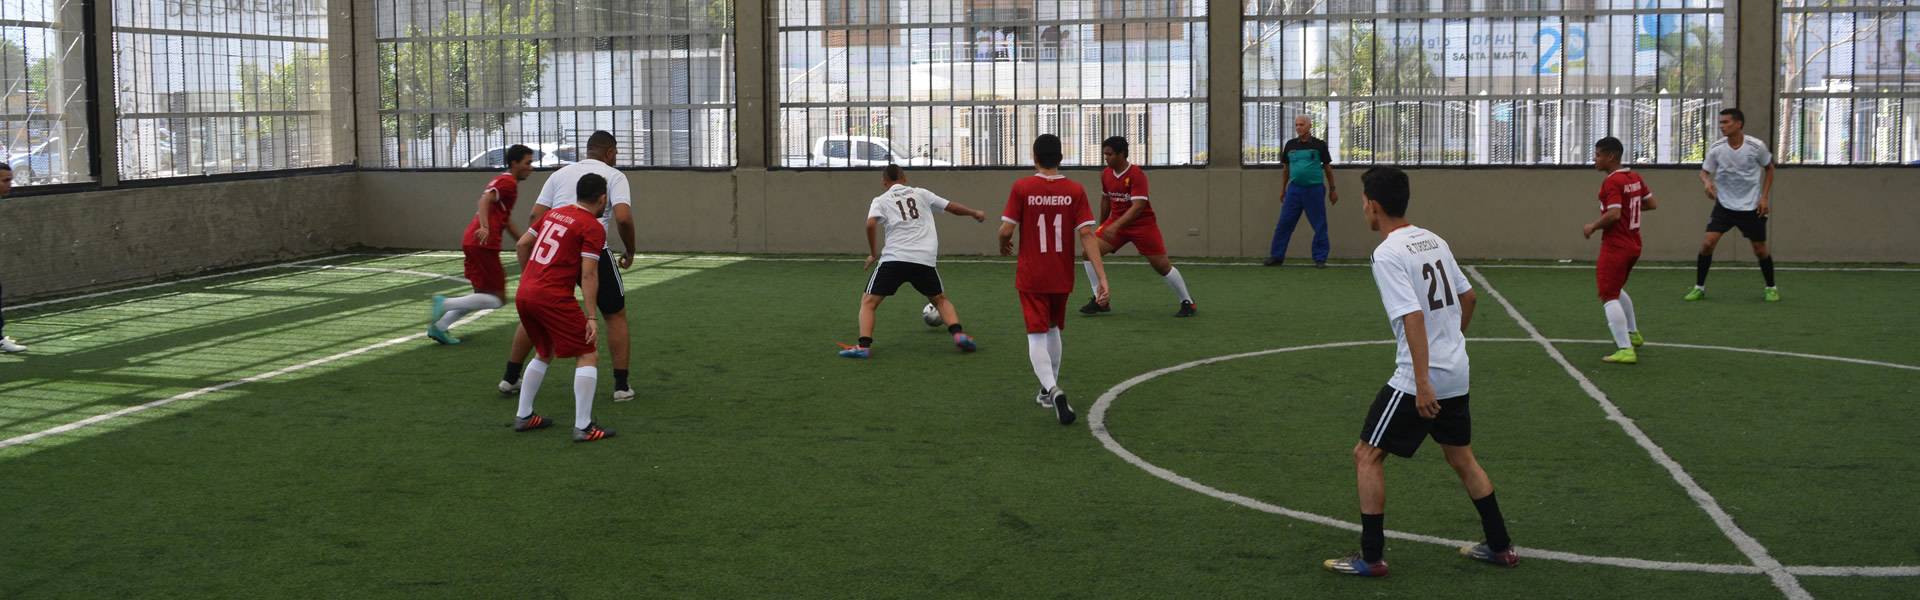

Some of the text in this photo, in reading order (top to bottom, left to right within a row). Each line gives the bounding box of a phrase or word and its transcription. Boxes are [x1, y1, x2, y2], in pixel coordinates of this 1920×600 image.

[1452, 52, 1486, 61] SANTA
[895, 197, 919, 220] 18
[1028, 195, 1072, 206] ROMERO
[1629, 196, 1641, 230] 10
[530, 220, 568, 265] 15
[1037, 214, 1063, 253] 11
[1422, 259, 1454, 311] 21
